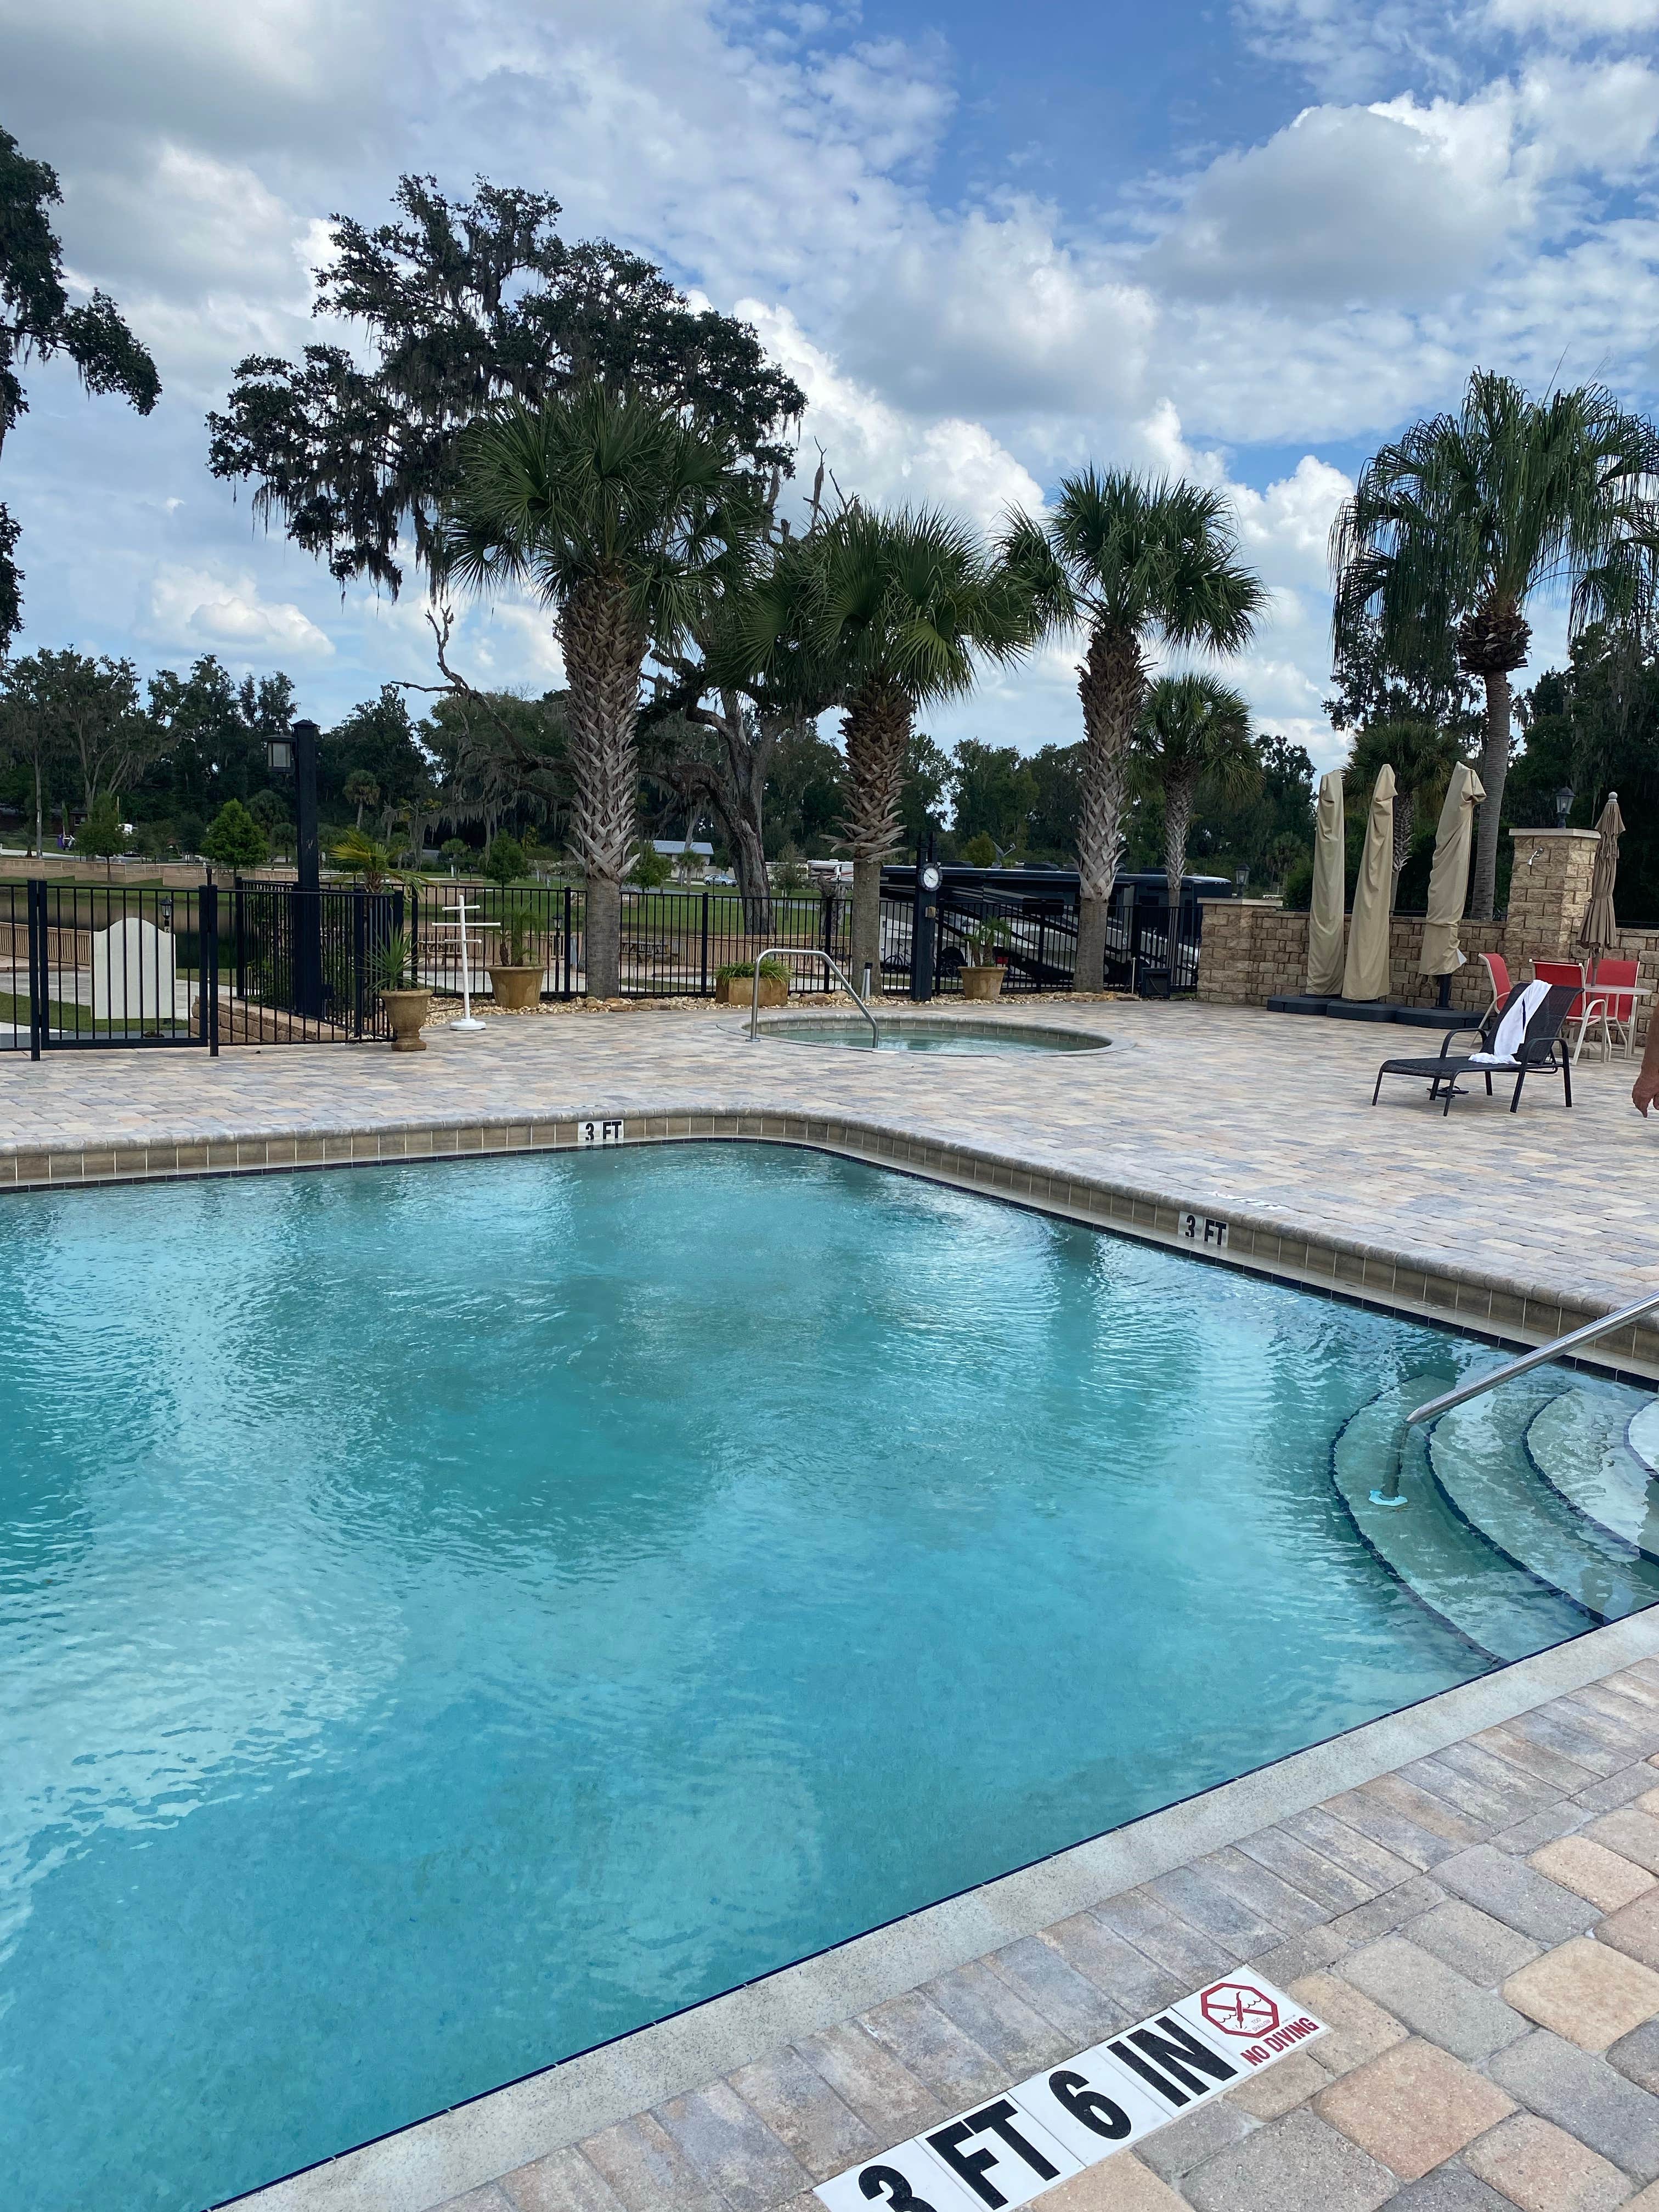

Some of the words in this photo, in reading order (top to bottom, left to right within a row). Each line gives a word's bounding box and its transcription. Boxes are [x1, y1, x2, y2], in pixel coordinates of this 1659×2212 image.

[585, 1122, 594, 1141] 3
[603, 1121, 622, 1139] FT
[1185, 1215, 1196, 1238] 3
[1204, 1218, 1227, 1245] FT
[1252, 2019, 1271, 2032] SHALLOW
[1240, 2045, 1270, 2066] NO
[1263, 2017, 1319, 2052] DIVING
[858, 2165, 938, 2212] 3
[925, 2098, 1060, 2210] FT
[1049, 2070, 1131, 2140] 6
[1107, 2016, 1238, 2107] IN
